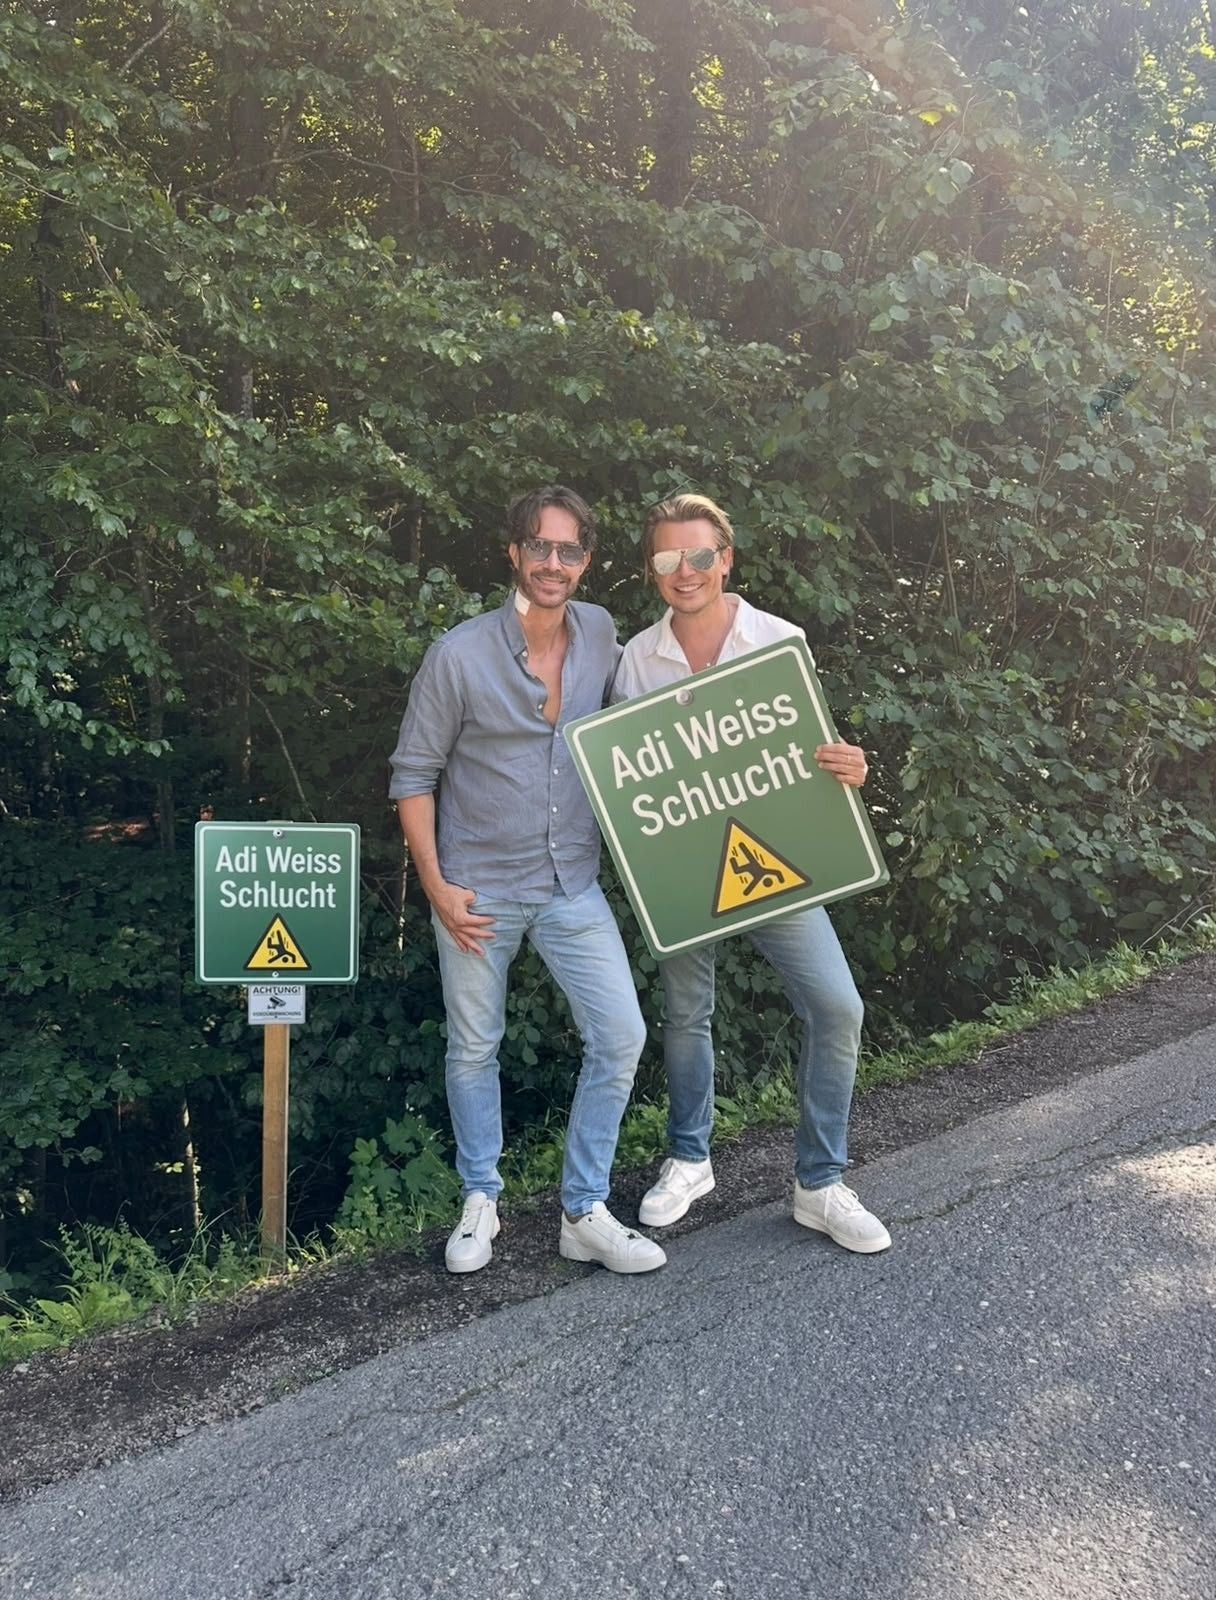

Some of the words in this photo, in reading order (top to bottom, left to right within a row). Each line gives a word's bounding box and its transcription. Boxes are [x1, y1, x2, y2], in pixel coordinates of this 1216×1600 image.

[610, 730, 674, 789] Adi
[674, 693, 799, 760] Weiss
[632, 742, 812, 836] Schlucht
[215, 845, 257, 873] Adi
[266, 846, 342, 874] Weiss
[219, 880, 336, 908] Schlucht
[252, 985, 302, 994] ACHTUNG!
